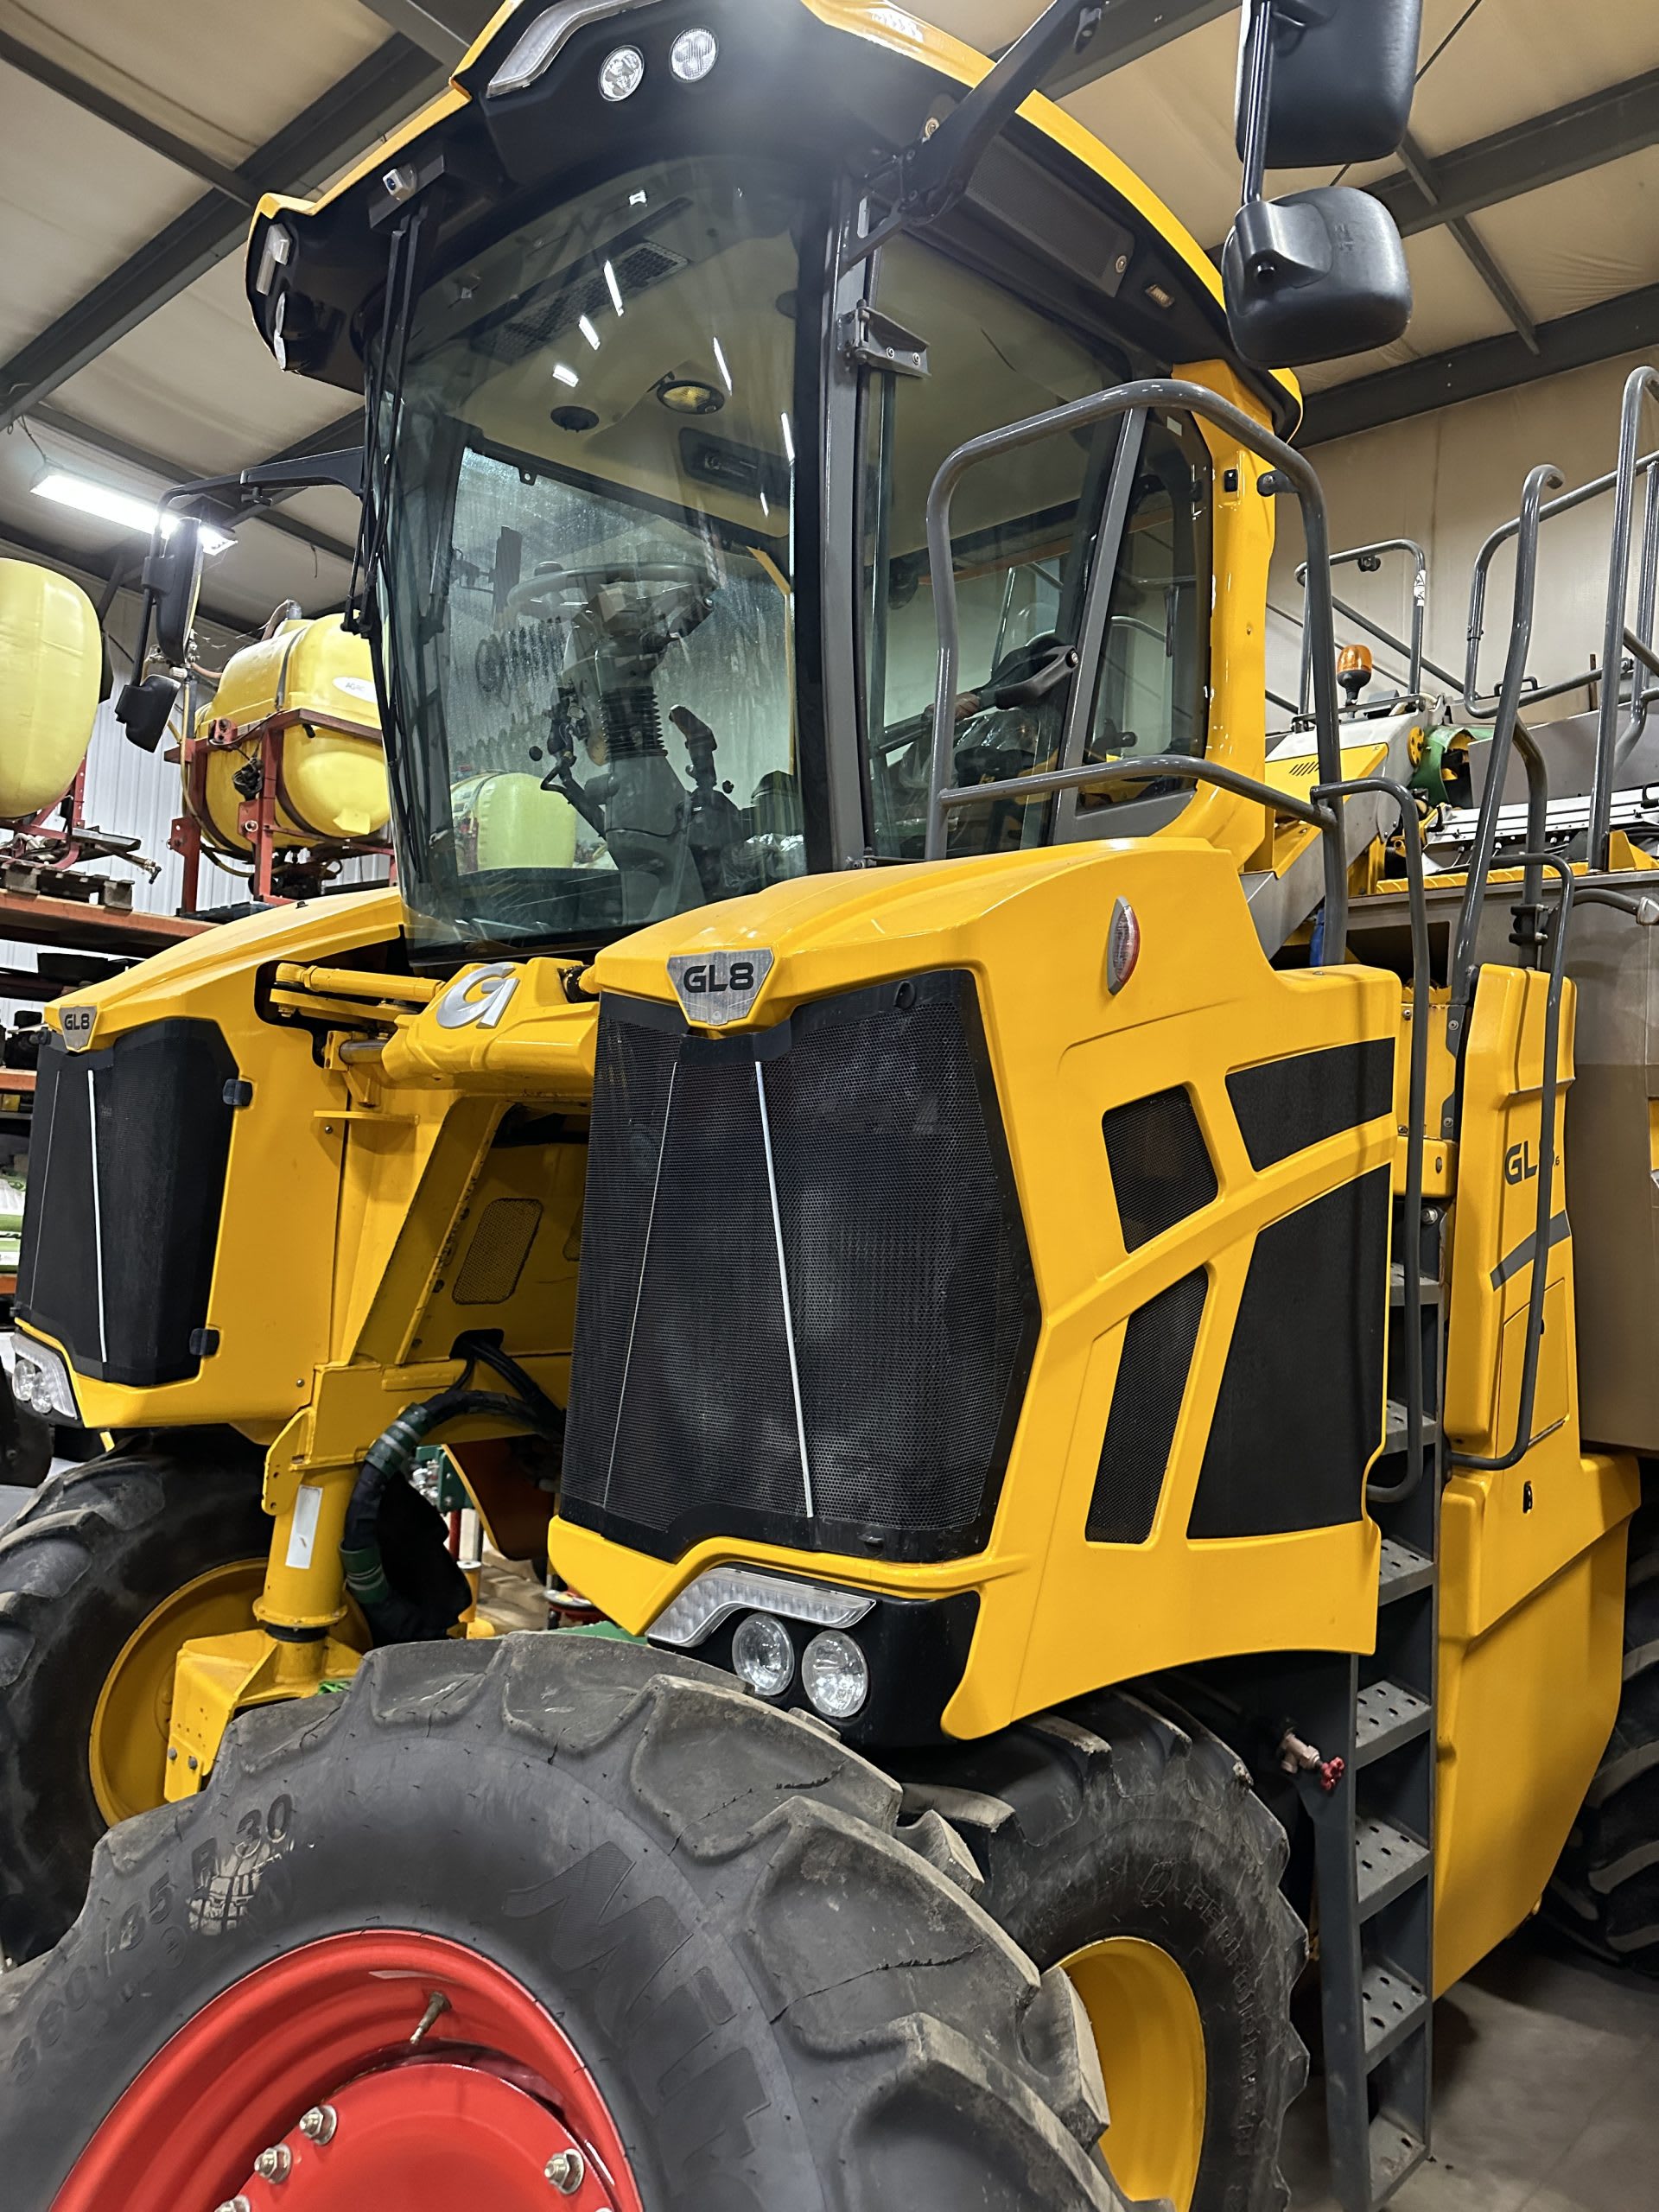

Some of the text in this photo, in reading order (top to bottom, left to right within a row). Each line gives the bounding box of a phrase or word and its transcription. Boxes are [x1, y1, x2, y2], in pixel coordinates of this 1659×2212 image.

[683, 962, 754, 994] GL8
[64, 1013, 90, 1031] GL8
[234, 1793, 295, 1859] 30
